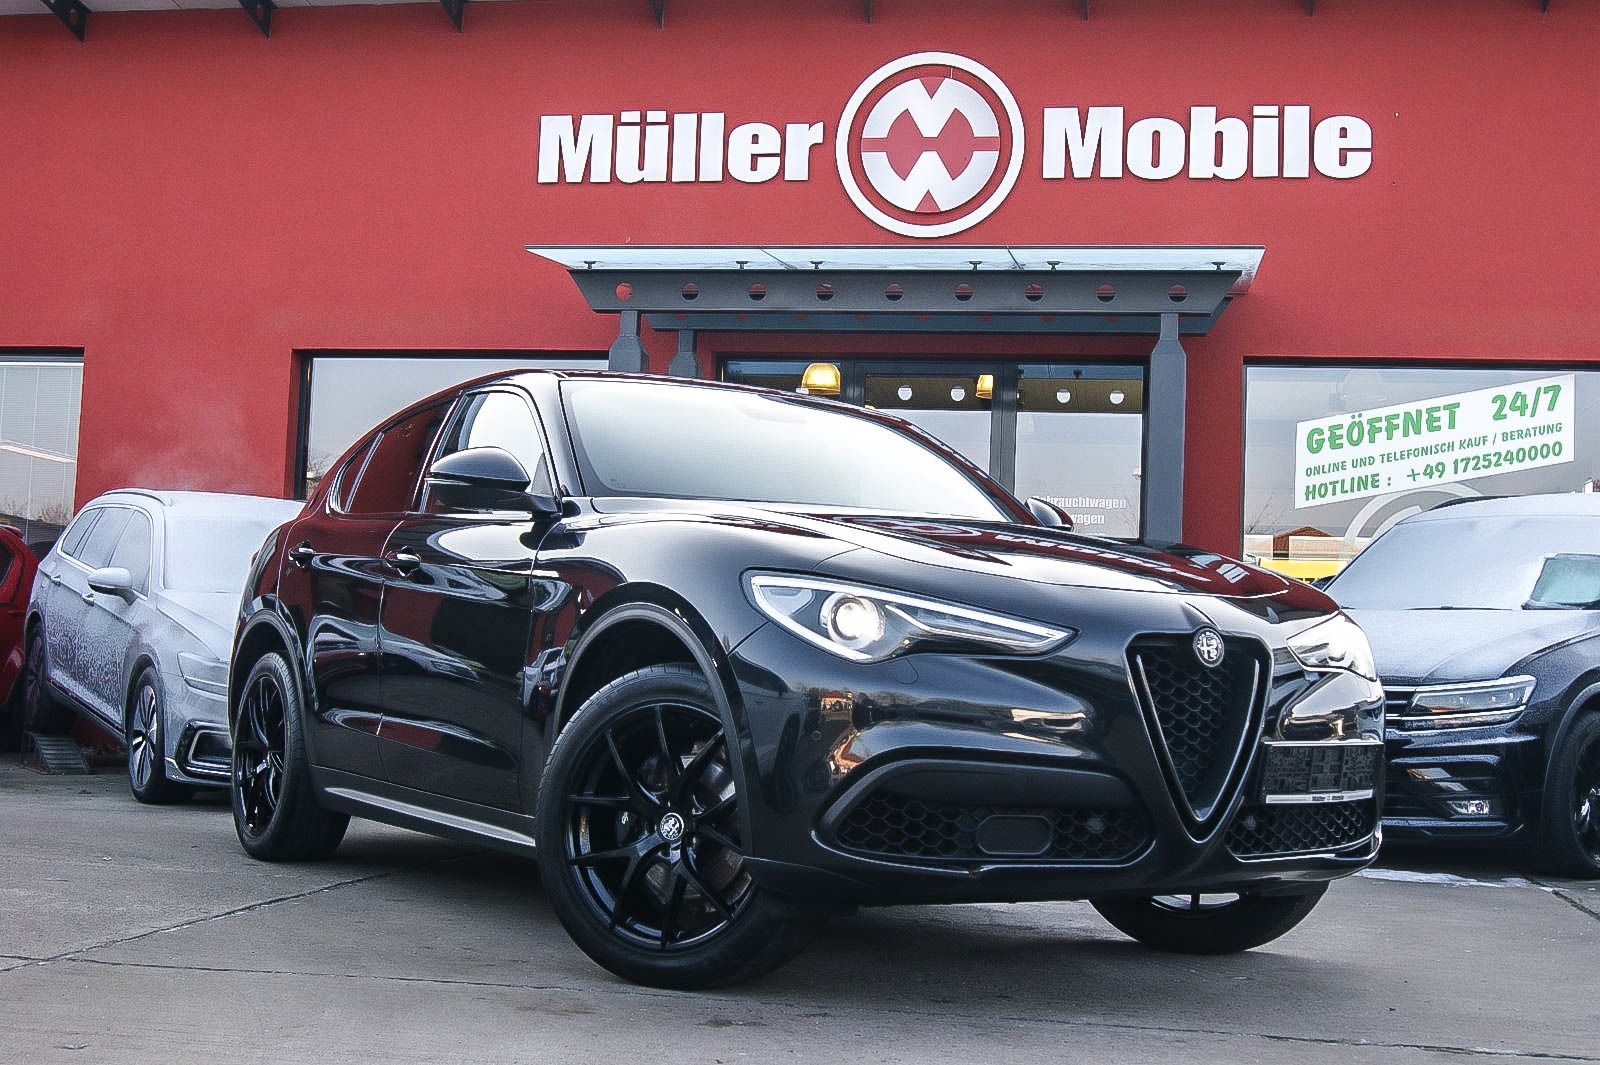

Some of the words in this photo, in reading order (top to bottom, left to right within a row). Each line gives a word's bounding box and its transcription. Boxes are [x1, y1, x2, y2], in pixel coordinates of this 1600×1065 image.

[537, 110, 824, 184] Müller
[1042, 104, 1373, 180] Mobile
[1305, 460, 1347, 478] ONLINE
[1351, 455, 1375, 469] UND
[1379, 441, 1455, 464] TELEFONISCH
[1459, 435, 1489, 450] KAUF
[1501, 422, 1563, 442] BERATUNG
[1306, 402, 1461, 455] GEÖFFNET
[1491, 384, 1562, 421] 24/7
[1304, 473, 1380, 501] HOTLINE
[1406, 461, 1446, 482] +49
[1453, 441, 1563, 475] 1725240000
